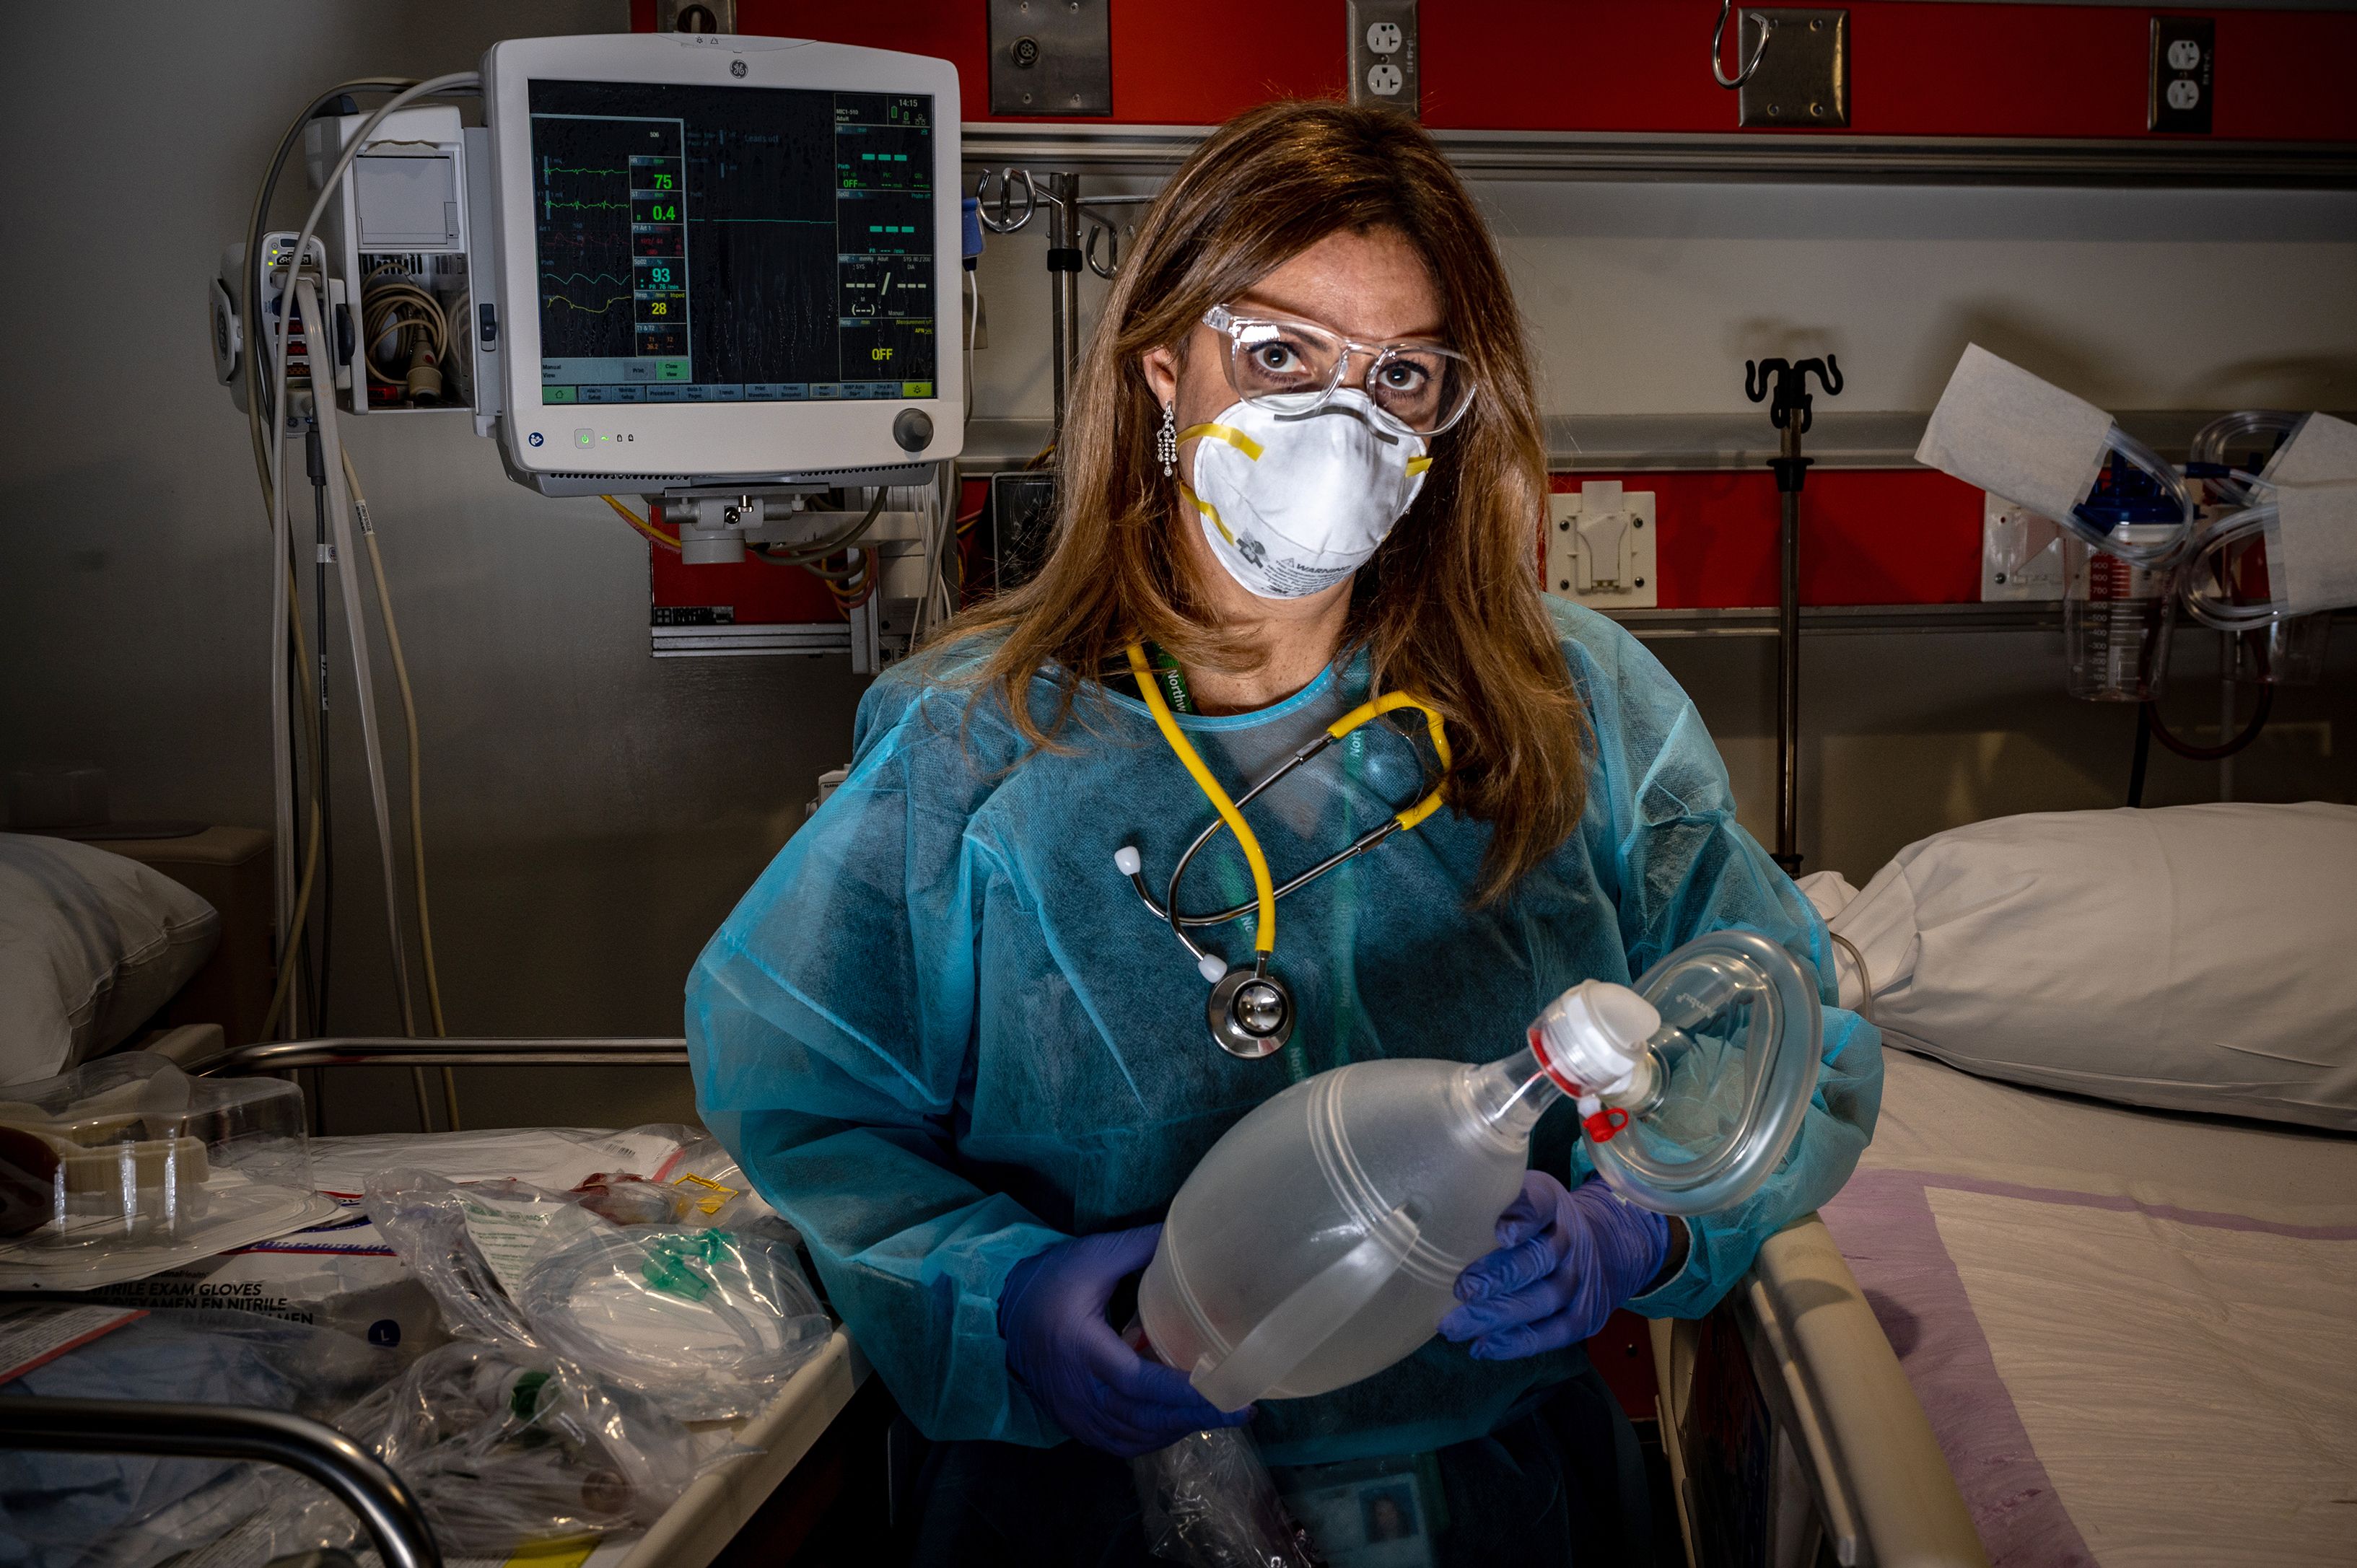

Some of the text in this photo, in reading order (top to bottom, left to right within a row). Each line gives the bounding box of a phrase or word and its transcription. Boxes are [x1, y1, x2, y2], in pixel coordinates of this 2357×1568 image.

[654, 174, 673, 189] 75
[652, 206, 675, 220] 0.4
[652, 268, 670, 282] 93
[652, 302, 667, 315] 28
[872, 349, 893, 360] OFF
[149, 1283, 195, 1296] EXAM
[199, 1284, 262, 1296] GLOVES
[202, 1298, 223, 1309] EN
[228, 1298, 288, 1311] NITRILE
[380, 1329, 390, 1341] L
